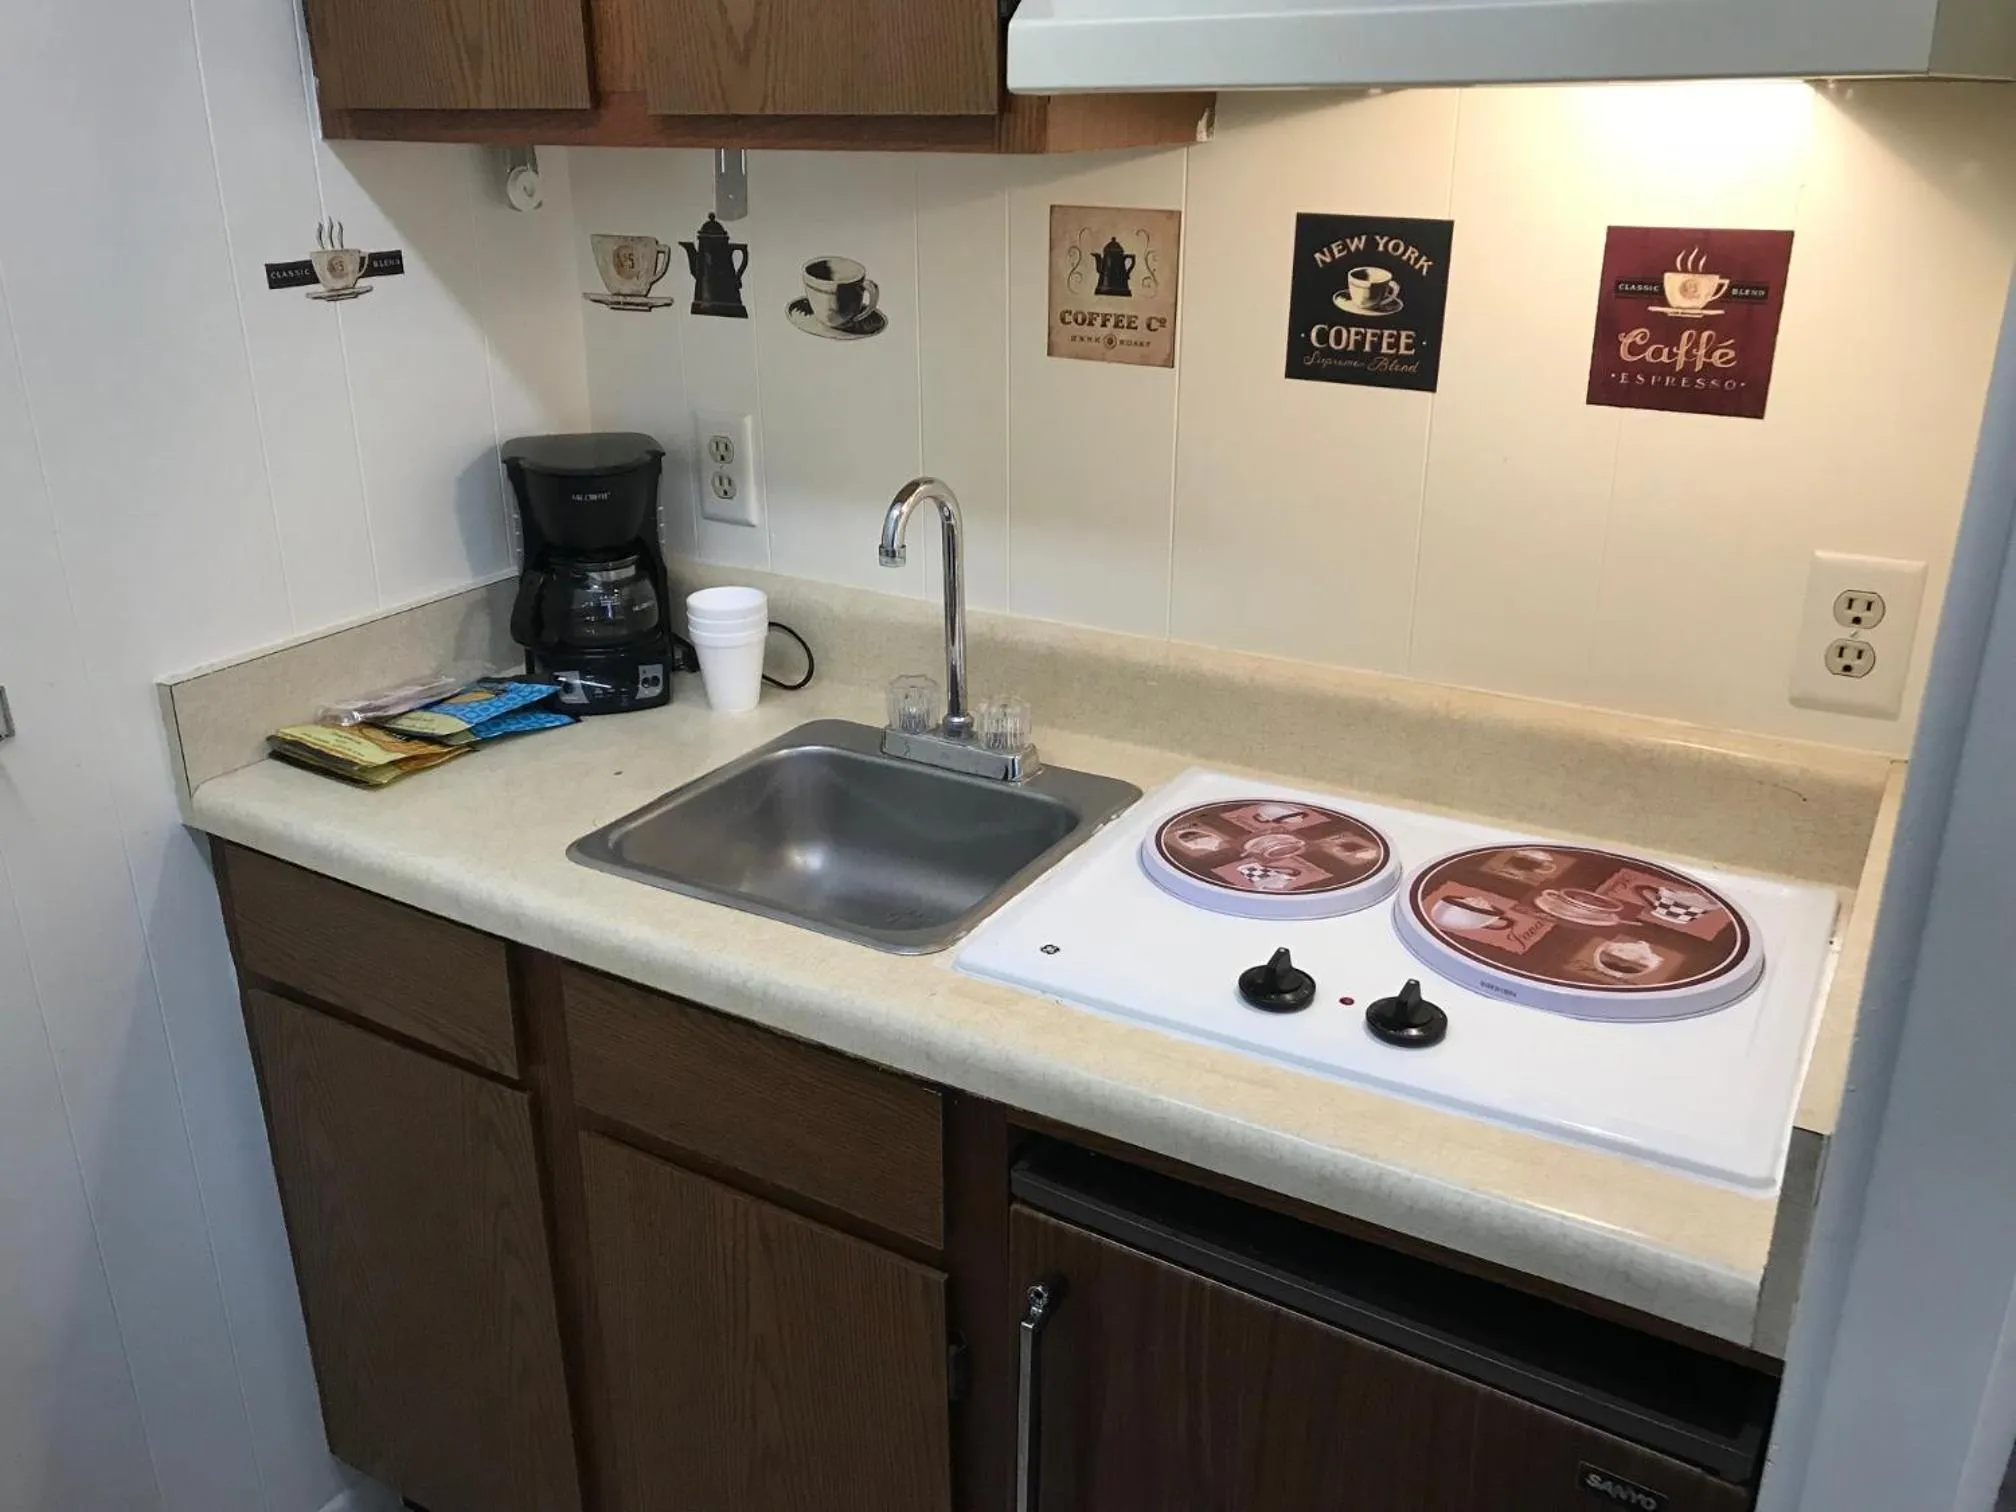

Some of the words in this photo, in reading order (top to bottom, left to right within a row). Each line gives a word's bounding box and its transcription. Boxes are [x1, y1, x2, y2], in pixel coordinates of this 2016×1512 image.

[1313, 234, 1367, 268] NEW
[1374, 235, 1434, 277] YORK
[270, 269, 310, 280] CLASSIC
[1618, 283, 1660, 292] CLASSIC
[1731, 288, 1766, 297] BLEND
[1059, 309, 1139, 331] COFFEE
[1310, 324, 1416, 355] COFFEE
[1619, 372, 1736, 390] ESPRESSO
[1585, 1473, 1657, 1511] SANYO
